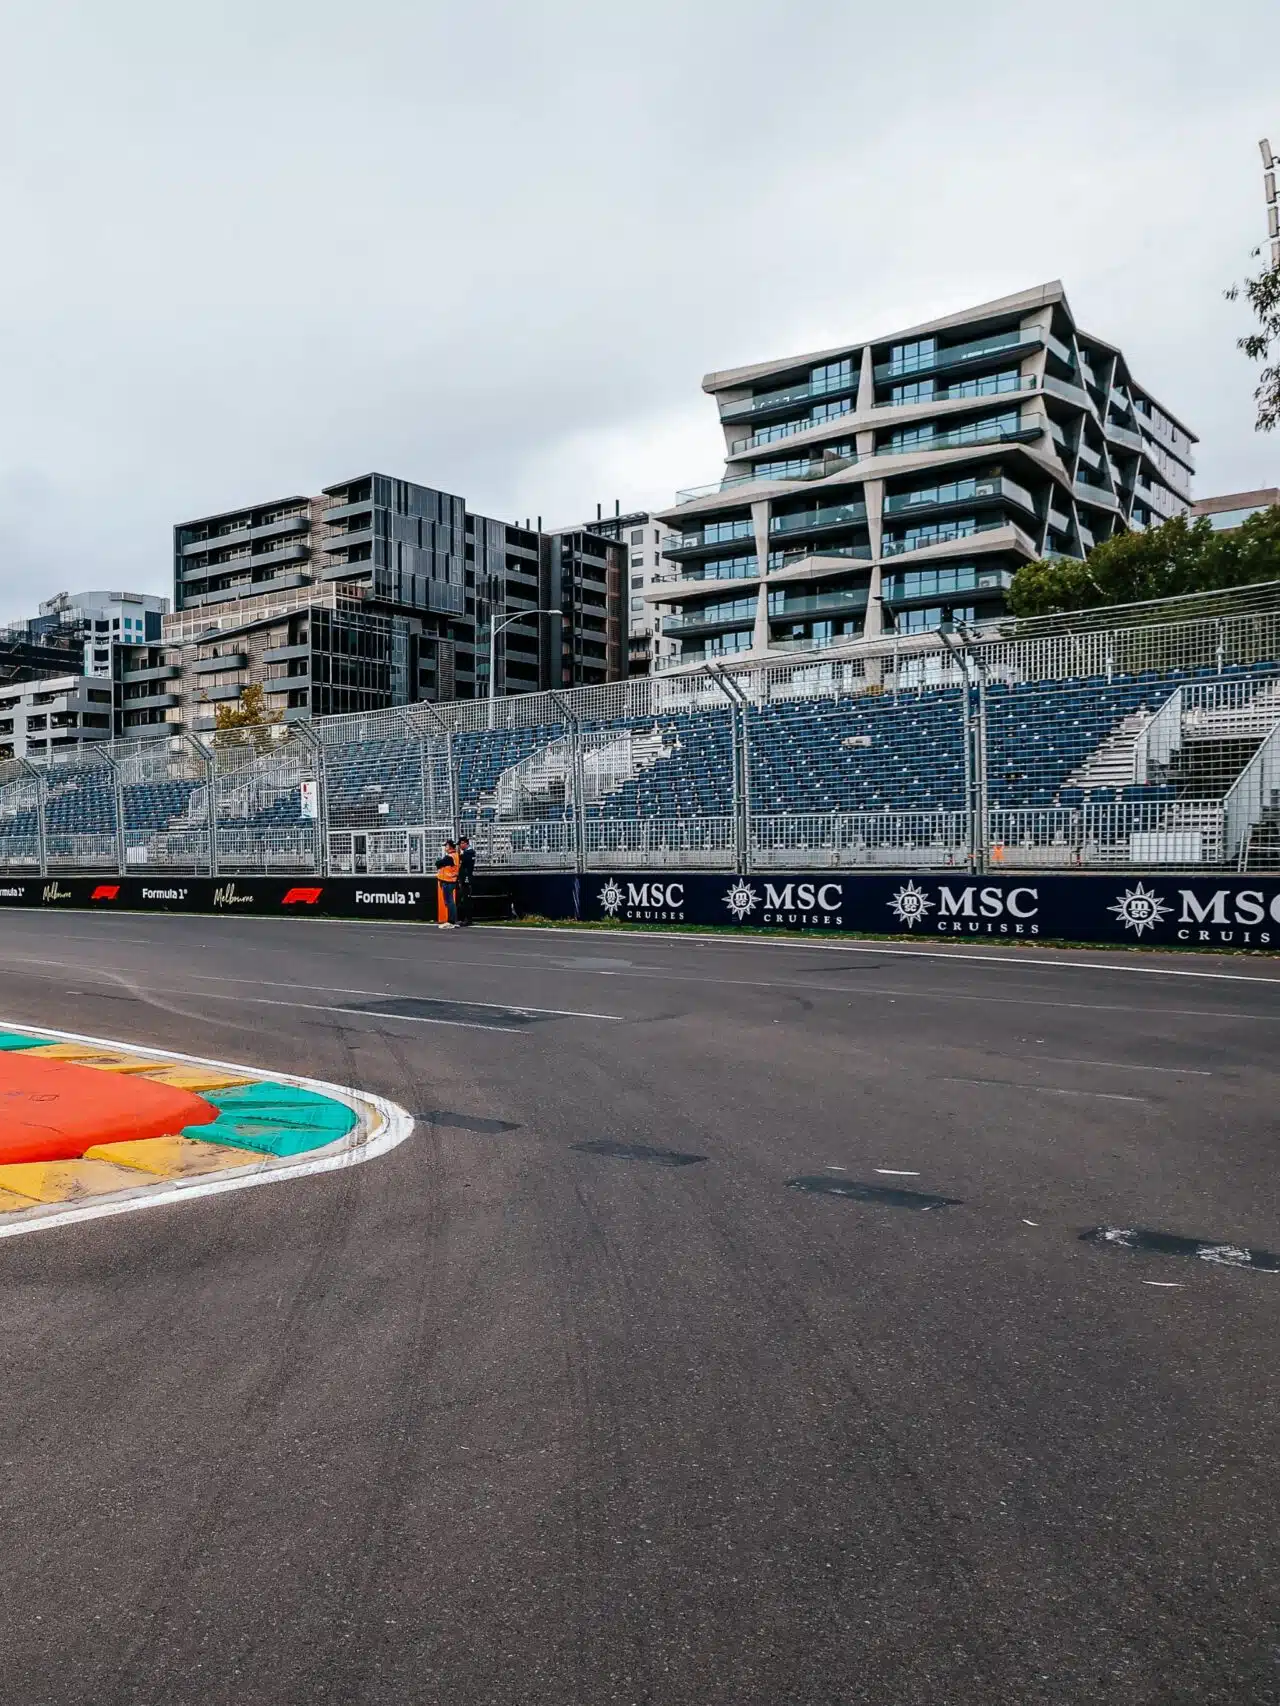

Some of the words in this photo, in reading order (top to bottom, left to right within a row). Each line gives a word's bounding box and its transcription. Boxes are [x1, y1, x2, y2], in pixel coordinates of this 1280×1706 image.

[43, 881, 72, 901] Melbourne
[142, 888, 178, 899] Formula
[213, 883, 255, 908] Melbourne
[355, 890, 406, 905] Formula
[627, 882, 684, 908] MSC
[764, 883, 843, 911] MSC
[937, 886, 1039, 918] MSC
[1177, 889, 1280, 925] MS
[627, 910, 685, 920] CRUISES
[764, 914, 843, 925] CRUISES
[937, 921, 1039, 934] CRUISES
